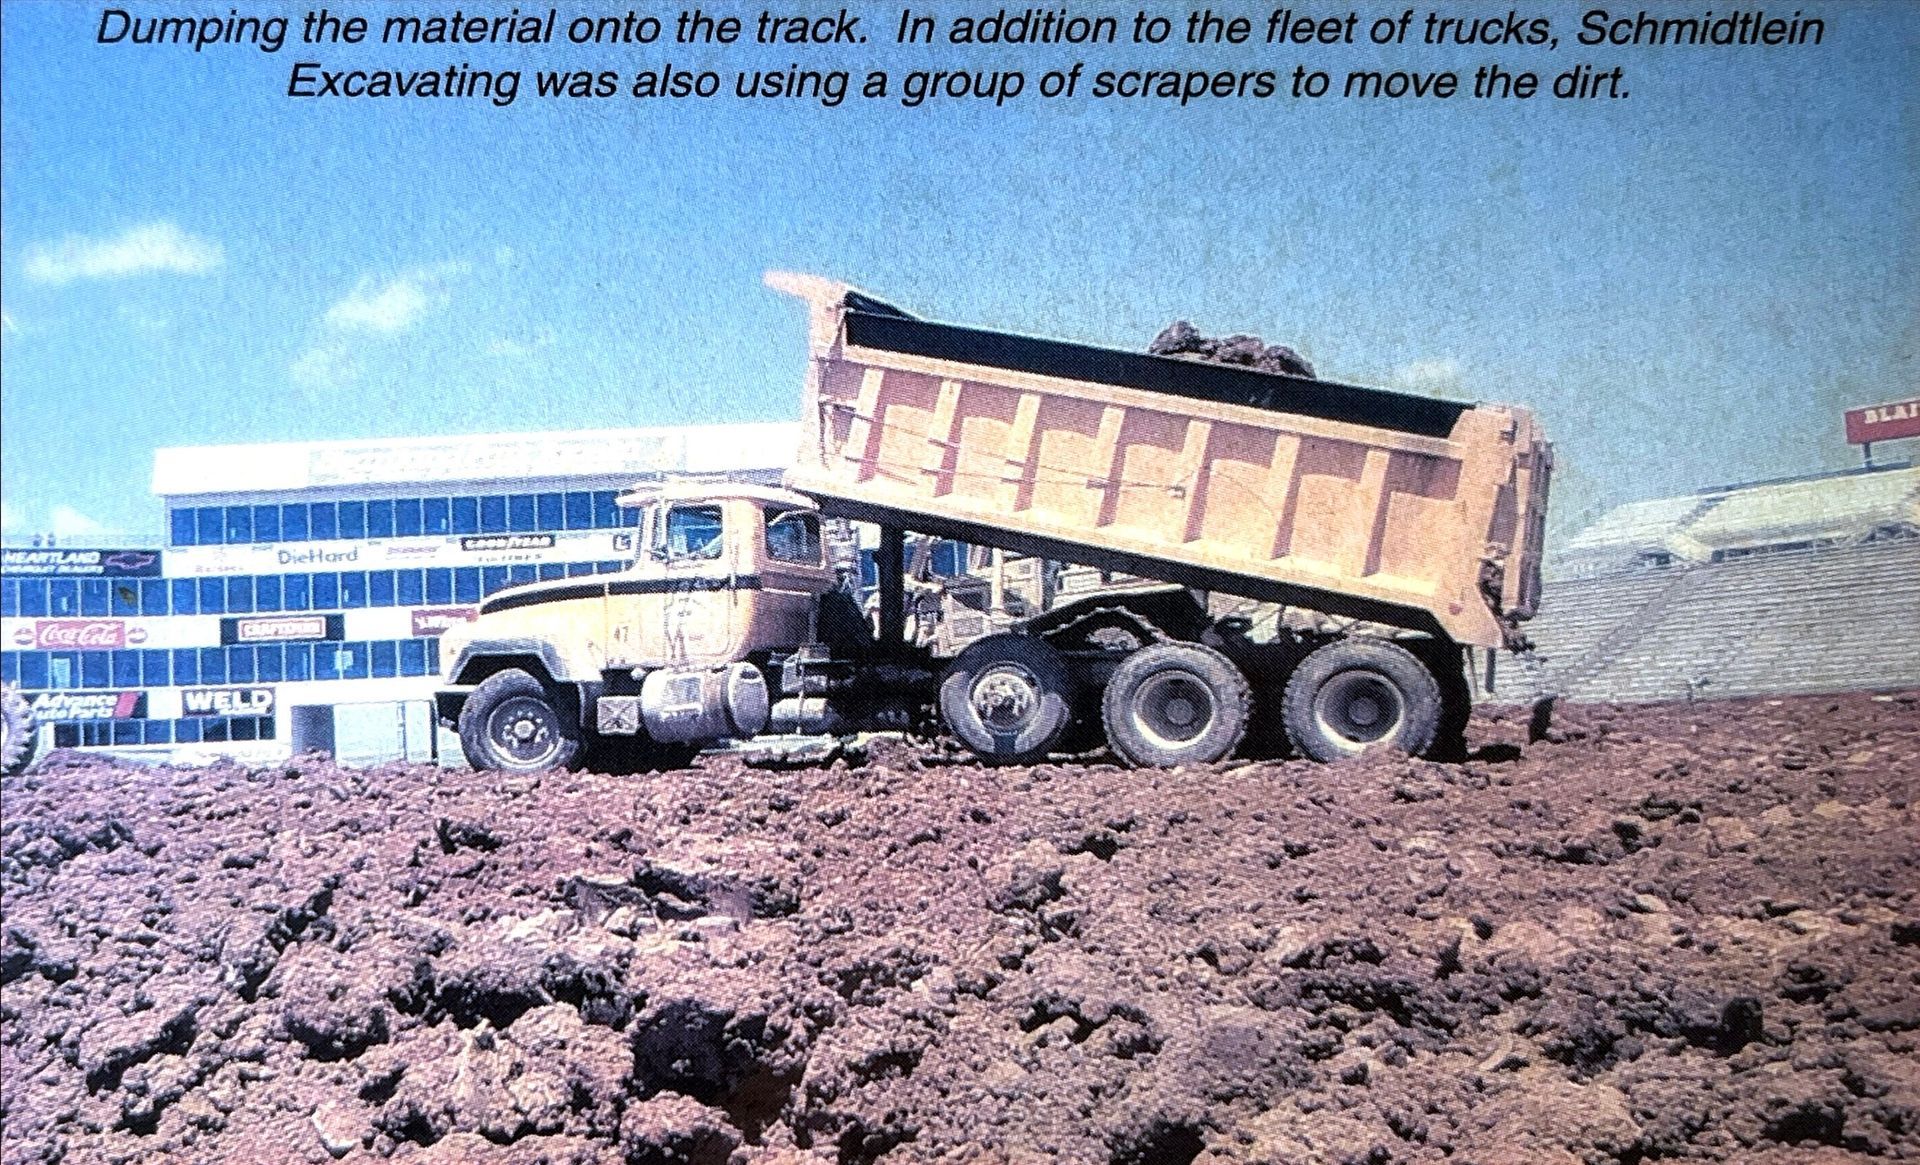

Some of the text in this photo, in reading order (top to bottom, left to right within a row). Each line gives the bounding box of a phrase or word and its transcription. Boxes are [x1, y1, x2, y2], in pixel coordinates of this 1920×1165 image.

[278, 548, 358, 565] DieHard
[31, 692, 118, 709] Advance
[186, 690, 273, 712] WELD
